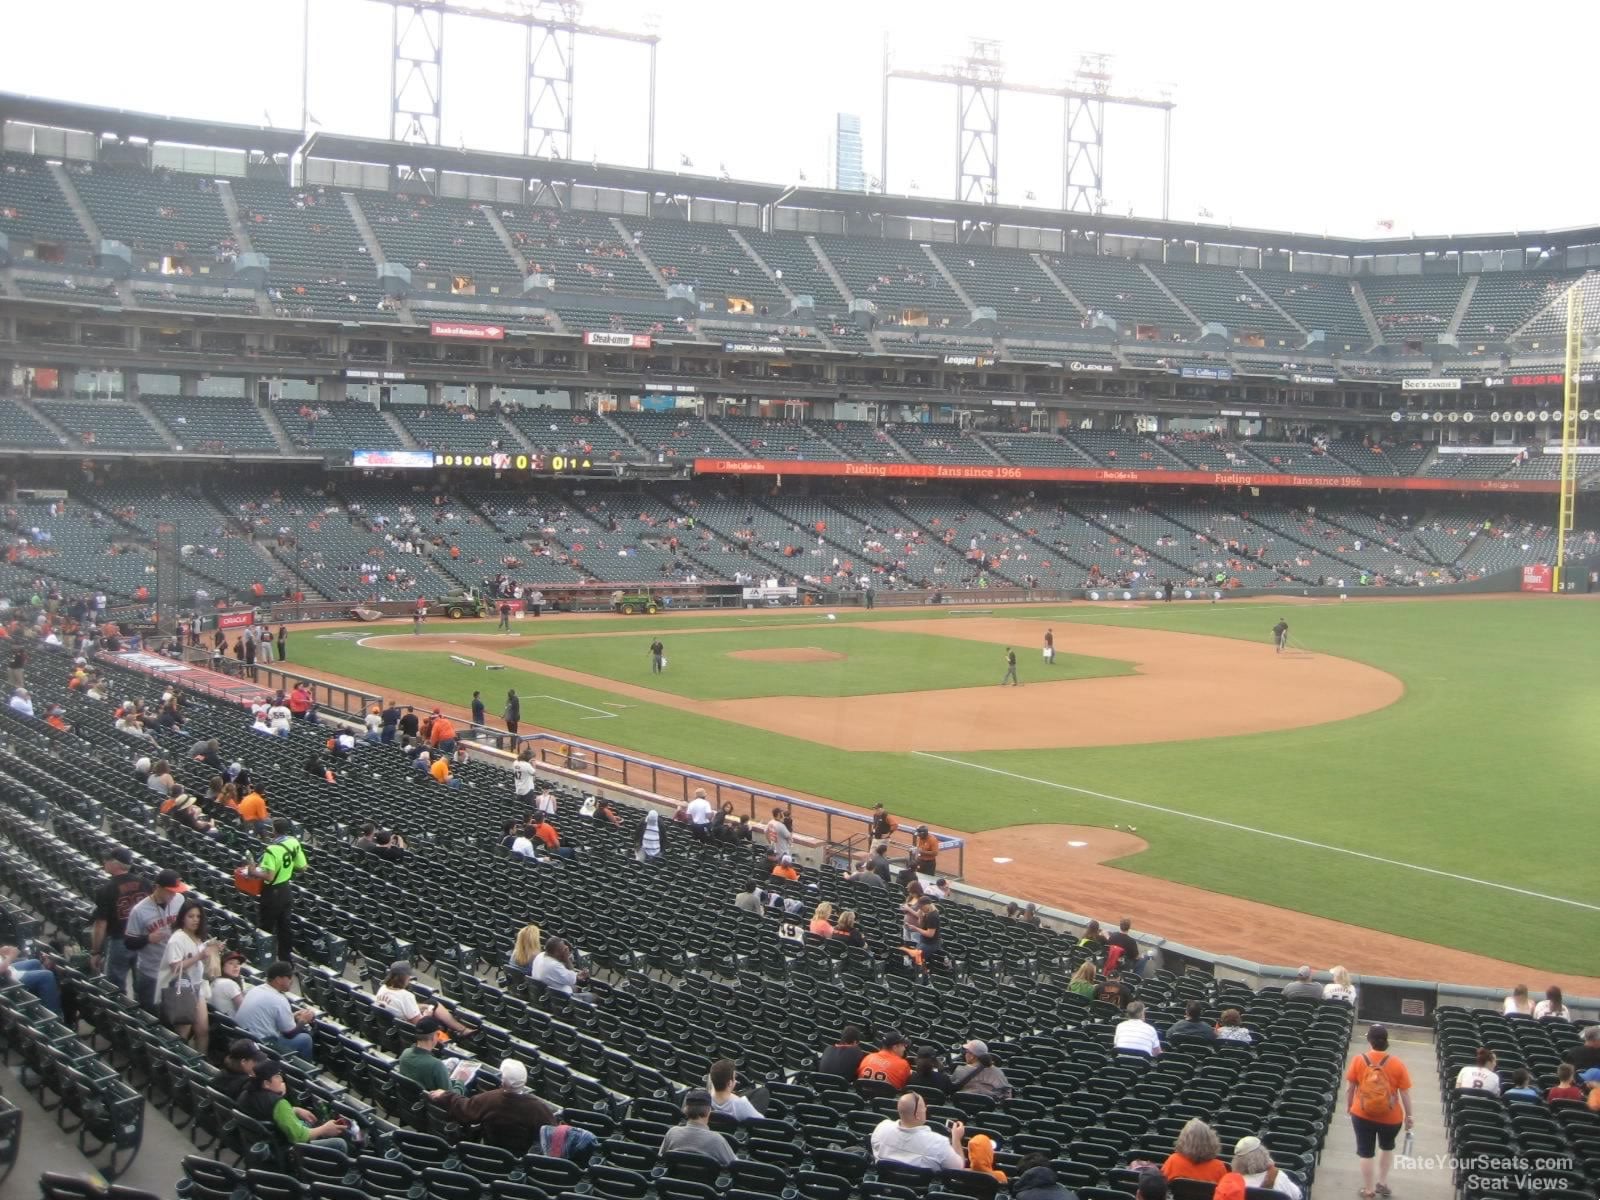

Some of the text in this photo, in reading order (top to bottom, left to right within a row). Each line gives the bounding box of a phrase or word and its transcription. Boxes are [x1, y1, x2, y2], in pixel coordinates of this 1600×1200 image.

[436, 326, 451, 334] Bank
[459, 328, 484, 336] America
[592, 333, 631, 345] Steak-umm
[734, 343, 785, 353] KONICA MINOLTA
[1404, 380, 1426, 388] See's
[1547, 374, 1563, 384] PM
[445, 455, 453, 466] 0
[464, 455, 472, 466] 0
[516, 455, 527, 469] 0
[552, 456, 563, 470] 0
[570, 458, 577, 468] 1
[845, 463, 1022, 478] Fueling GIANTS fans since 1966
[1215, 473, 1251, 485] Fueling
[1293, 475, 1313, 485] fans
[1315, 476, 1339, 486] since
[1341, 477, 1362, 486] 1966
[1524, 566, 1534, 574] FLY
[223, 616, 248, 625] ORACLE
